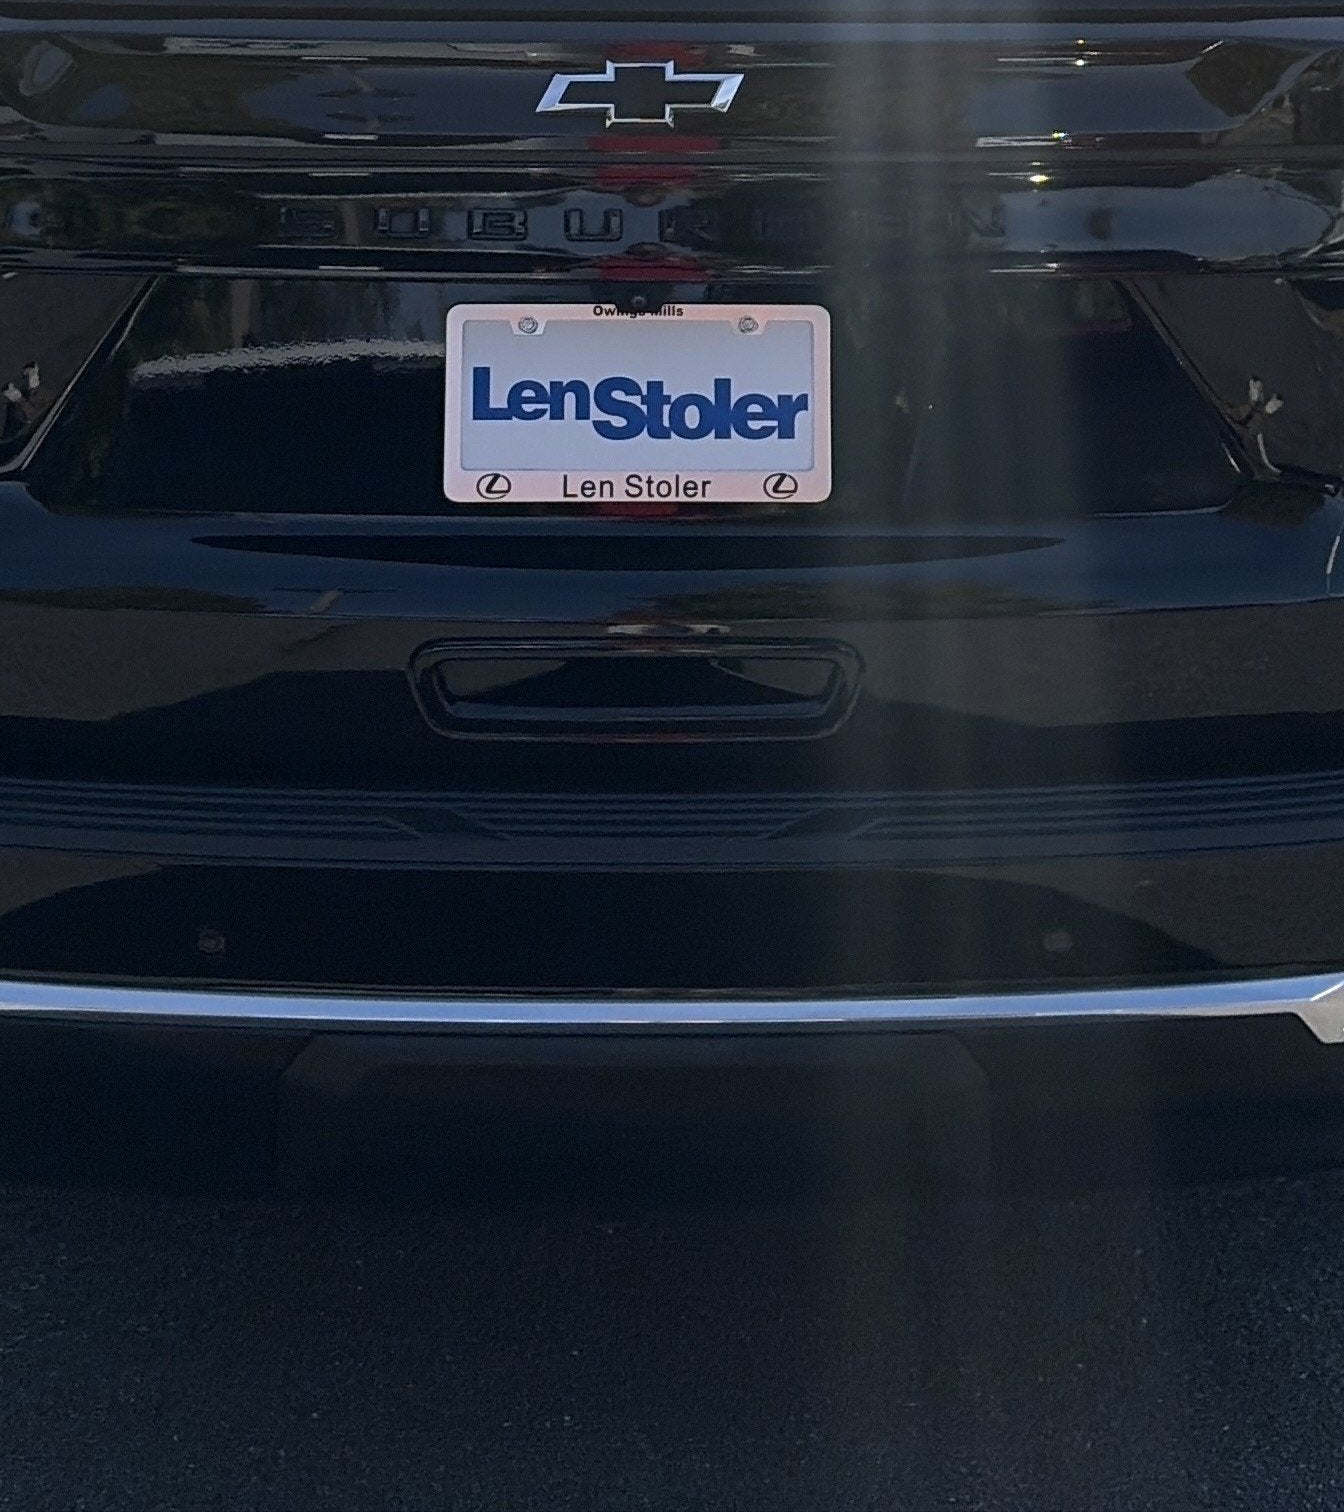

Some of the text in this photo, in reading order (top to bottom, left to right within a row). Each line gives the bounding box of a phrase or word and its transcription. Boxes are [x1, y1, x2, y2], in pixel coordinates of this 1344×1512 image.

[278, 205, 1007, 242] SUBURN
[562, 473, 712, 500] Len Stoler
